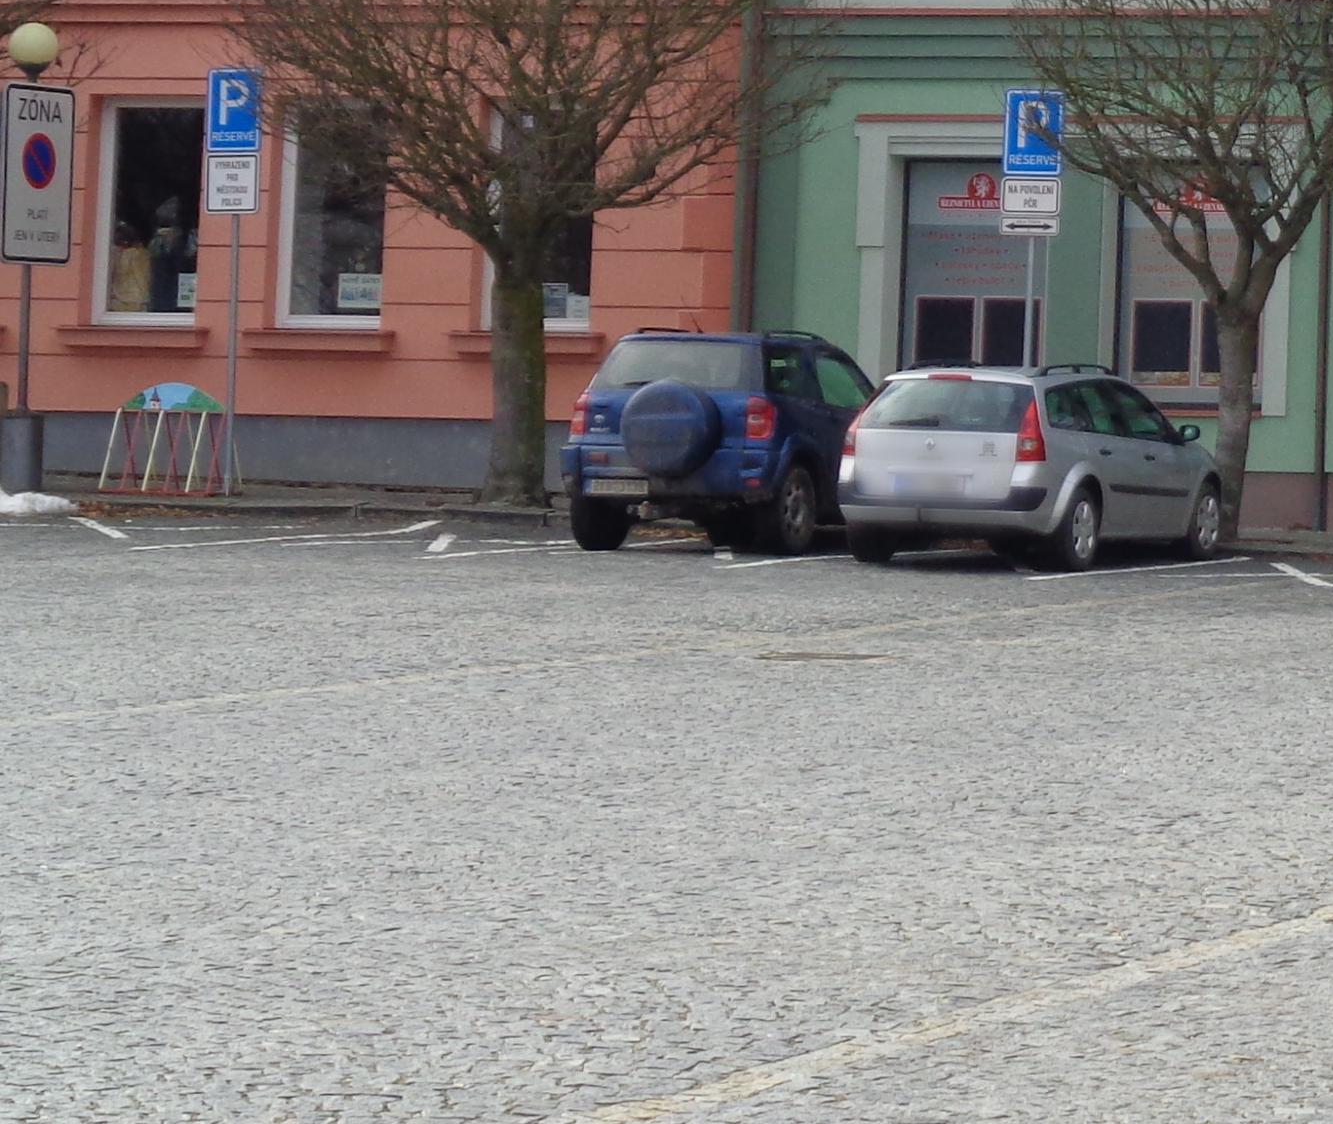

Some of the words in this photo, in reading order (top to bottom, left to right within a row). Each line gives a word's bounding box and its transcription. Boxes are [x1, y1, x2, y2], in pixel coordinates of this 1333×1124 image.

[17, 92, 63, 124] ZÓNA
[219, 79, 250, 126] P
[1017, 100, 1050, 148] P
[1008, 184, 1019, 194] NA
[1020, 184, 1055, 195] POVOLENÍ
